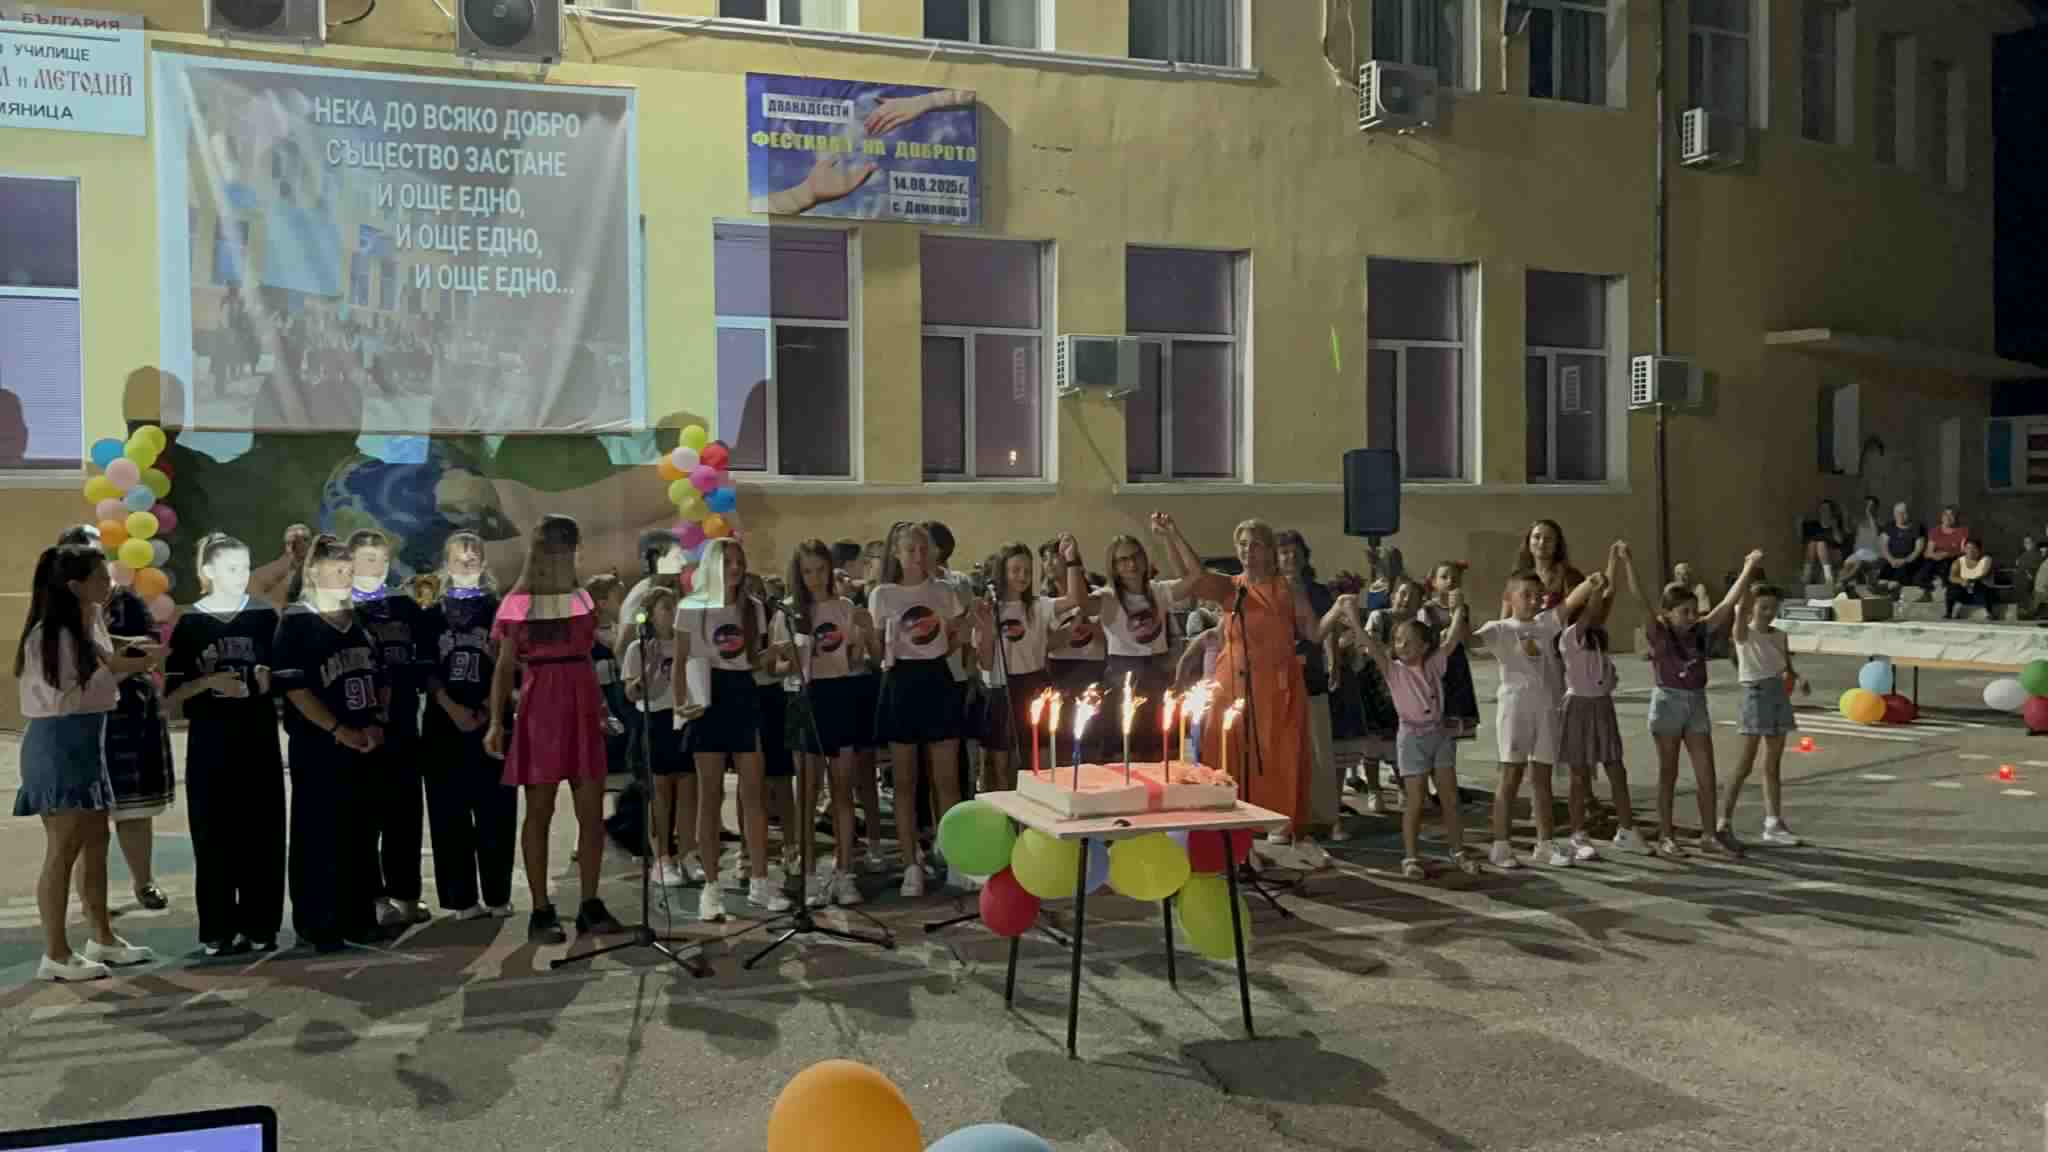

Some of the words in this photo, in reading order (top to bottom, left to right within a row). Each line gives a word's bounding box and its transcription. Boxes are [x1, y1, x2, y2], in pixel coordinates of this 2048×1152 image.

[22, 12, 121, 31] БЪЛГАРИЯ
[14, 43, 90, 62] УЧИЛИЩЕ
[313, 96, 377, 128] НЕКА
[383, 101, 417, 133] ДО
[423, 104, 497, 134] ВСЯКО
[503, 109, 581, 141] ДОБРО
[327, 139, 460, 172] СЪЩЕСТВО
[465, 146, 568, 178] ЗАСТАНЕ
[378, 184, 394, 208] И
[400, 184, 453, 215] ОЩЕ
[458, 187, 526, 219] ЕДНО,
[396, 224, 412, 249] И
[417, 224, 470, 255] ОЩЕ
[476, 226, 544, 259] ЕДНО,
[414, 265, 431, 290] И
[438, 265, 489, 296] ОЩЕ
[450, 651, 481, 684] 91
